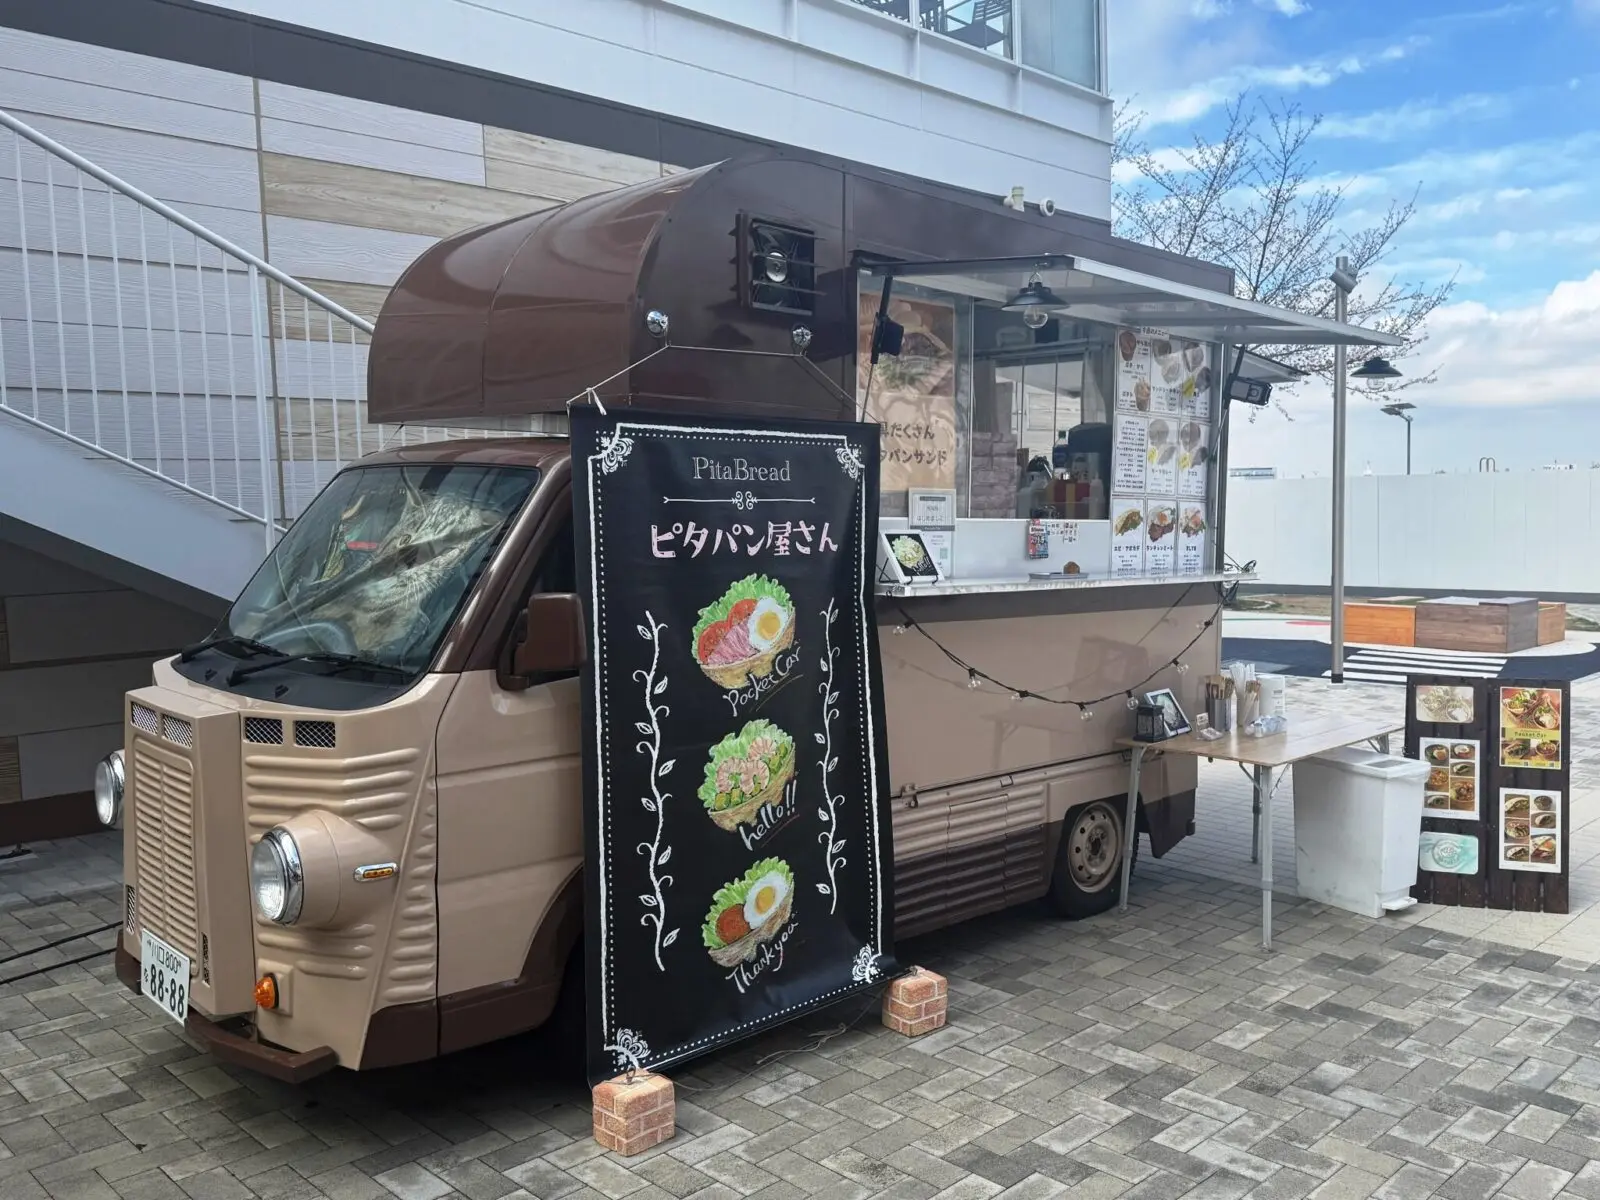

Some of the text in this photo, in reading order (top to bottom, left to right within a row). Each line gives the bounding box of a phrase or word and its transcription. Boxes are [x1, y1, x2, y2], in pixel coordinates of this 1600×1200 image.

[691, 456, 792, 482] PitaBread
[651, 519, 839, 559] ピタパン屋さん
[722, 646, 801, 717] Pocket Car
[739, 778, 797, 851] hello!!
[150, 963, 185, 1018] 88-88
